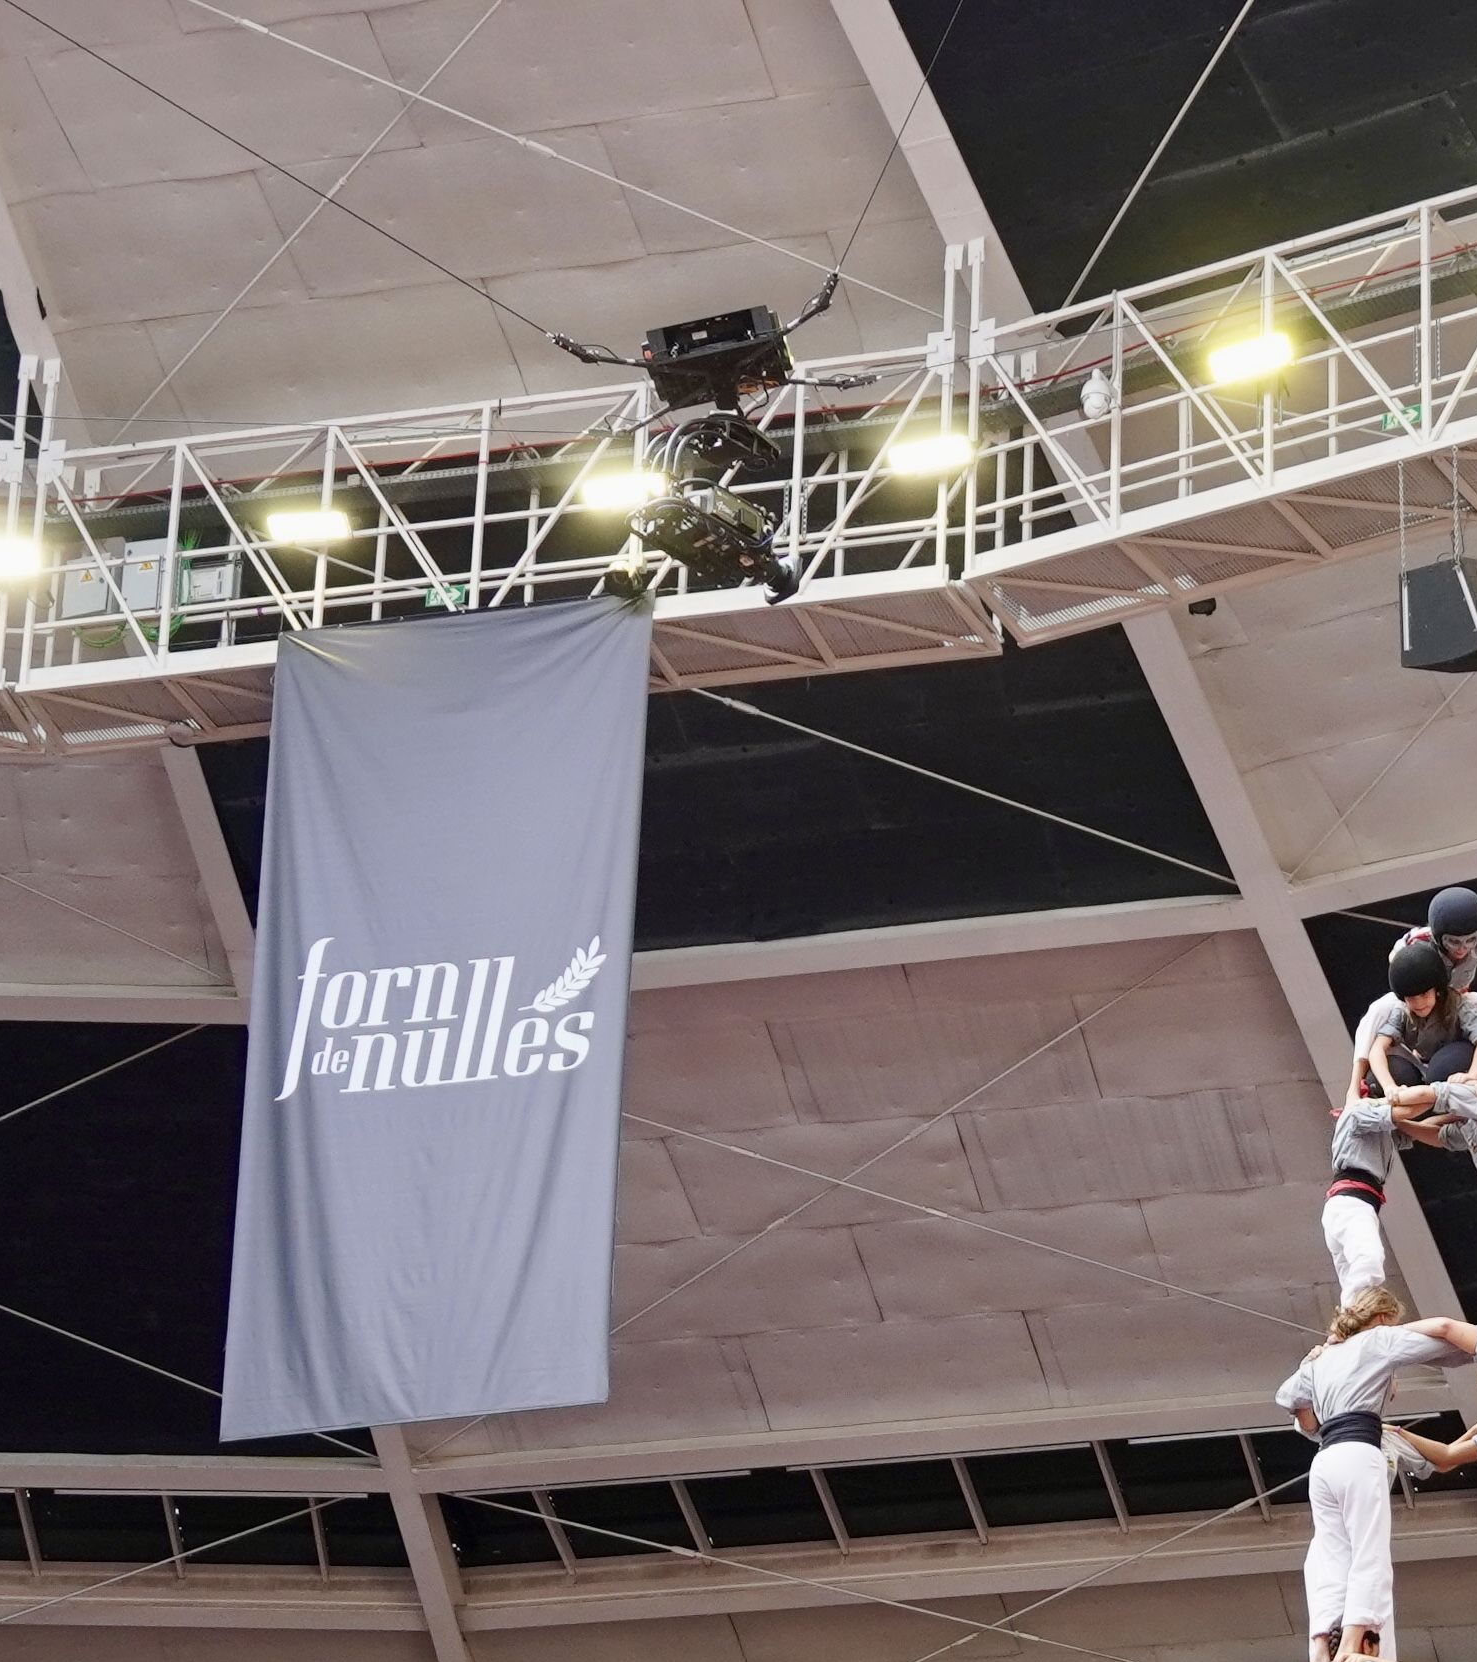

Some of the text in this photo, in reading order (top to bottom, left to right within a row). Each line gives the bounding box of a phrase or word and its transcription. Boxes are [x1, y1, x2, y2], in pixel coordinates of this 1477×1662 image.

[274, 936, 459, 1101] forn
[310, 956, 595, 1093] de nulles
